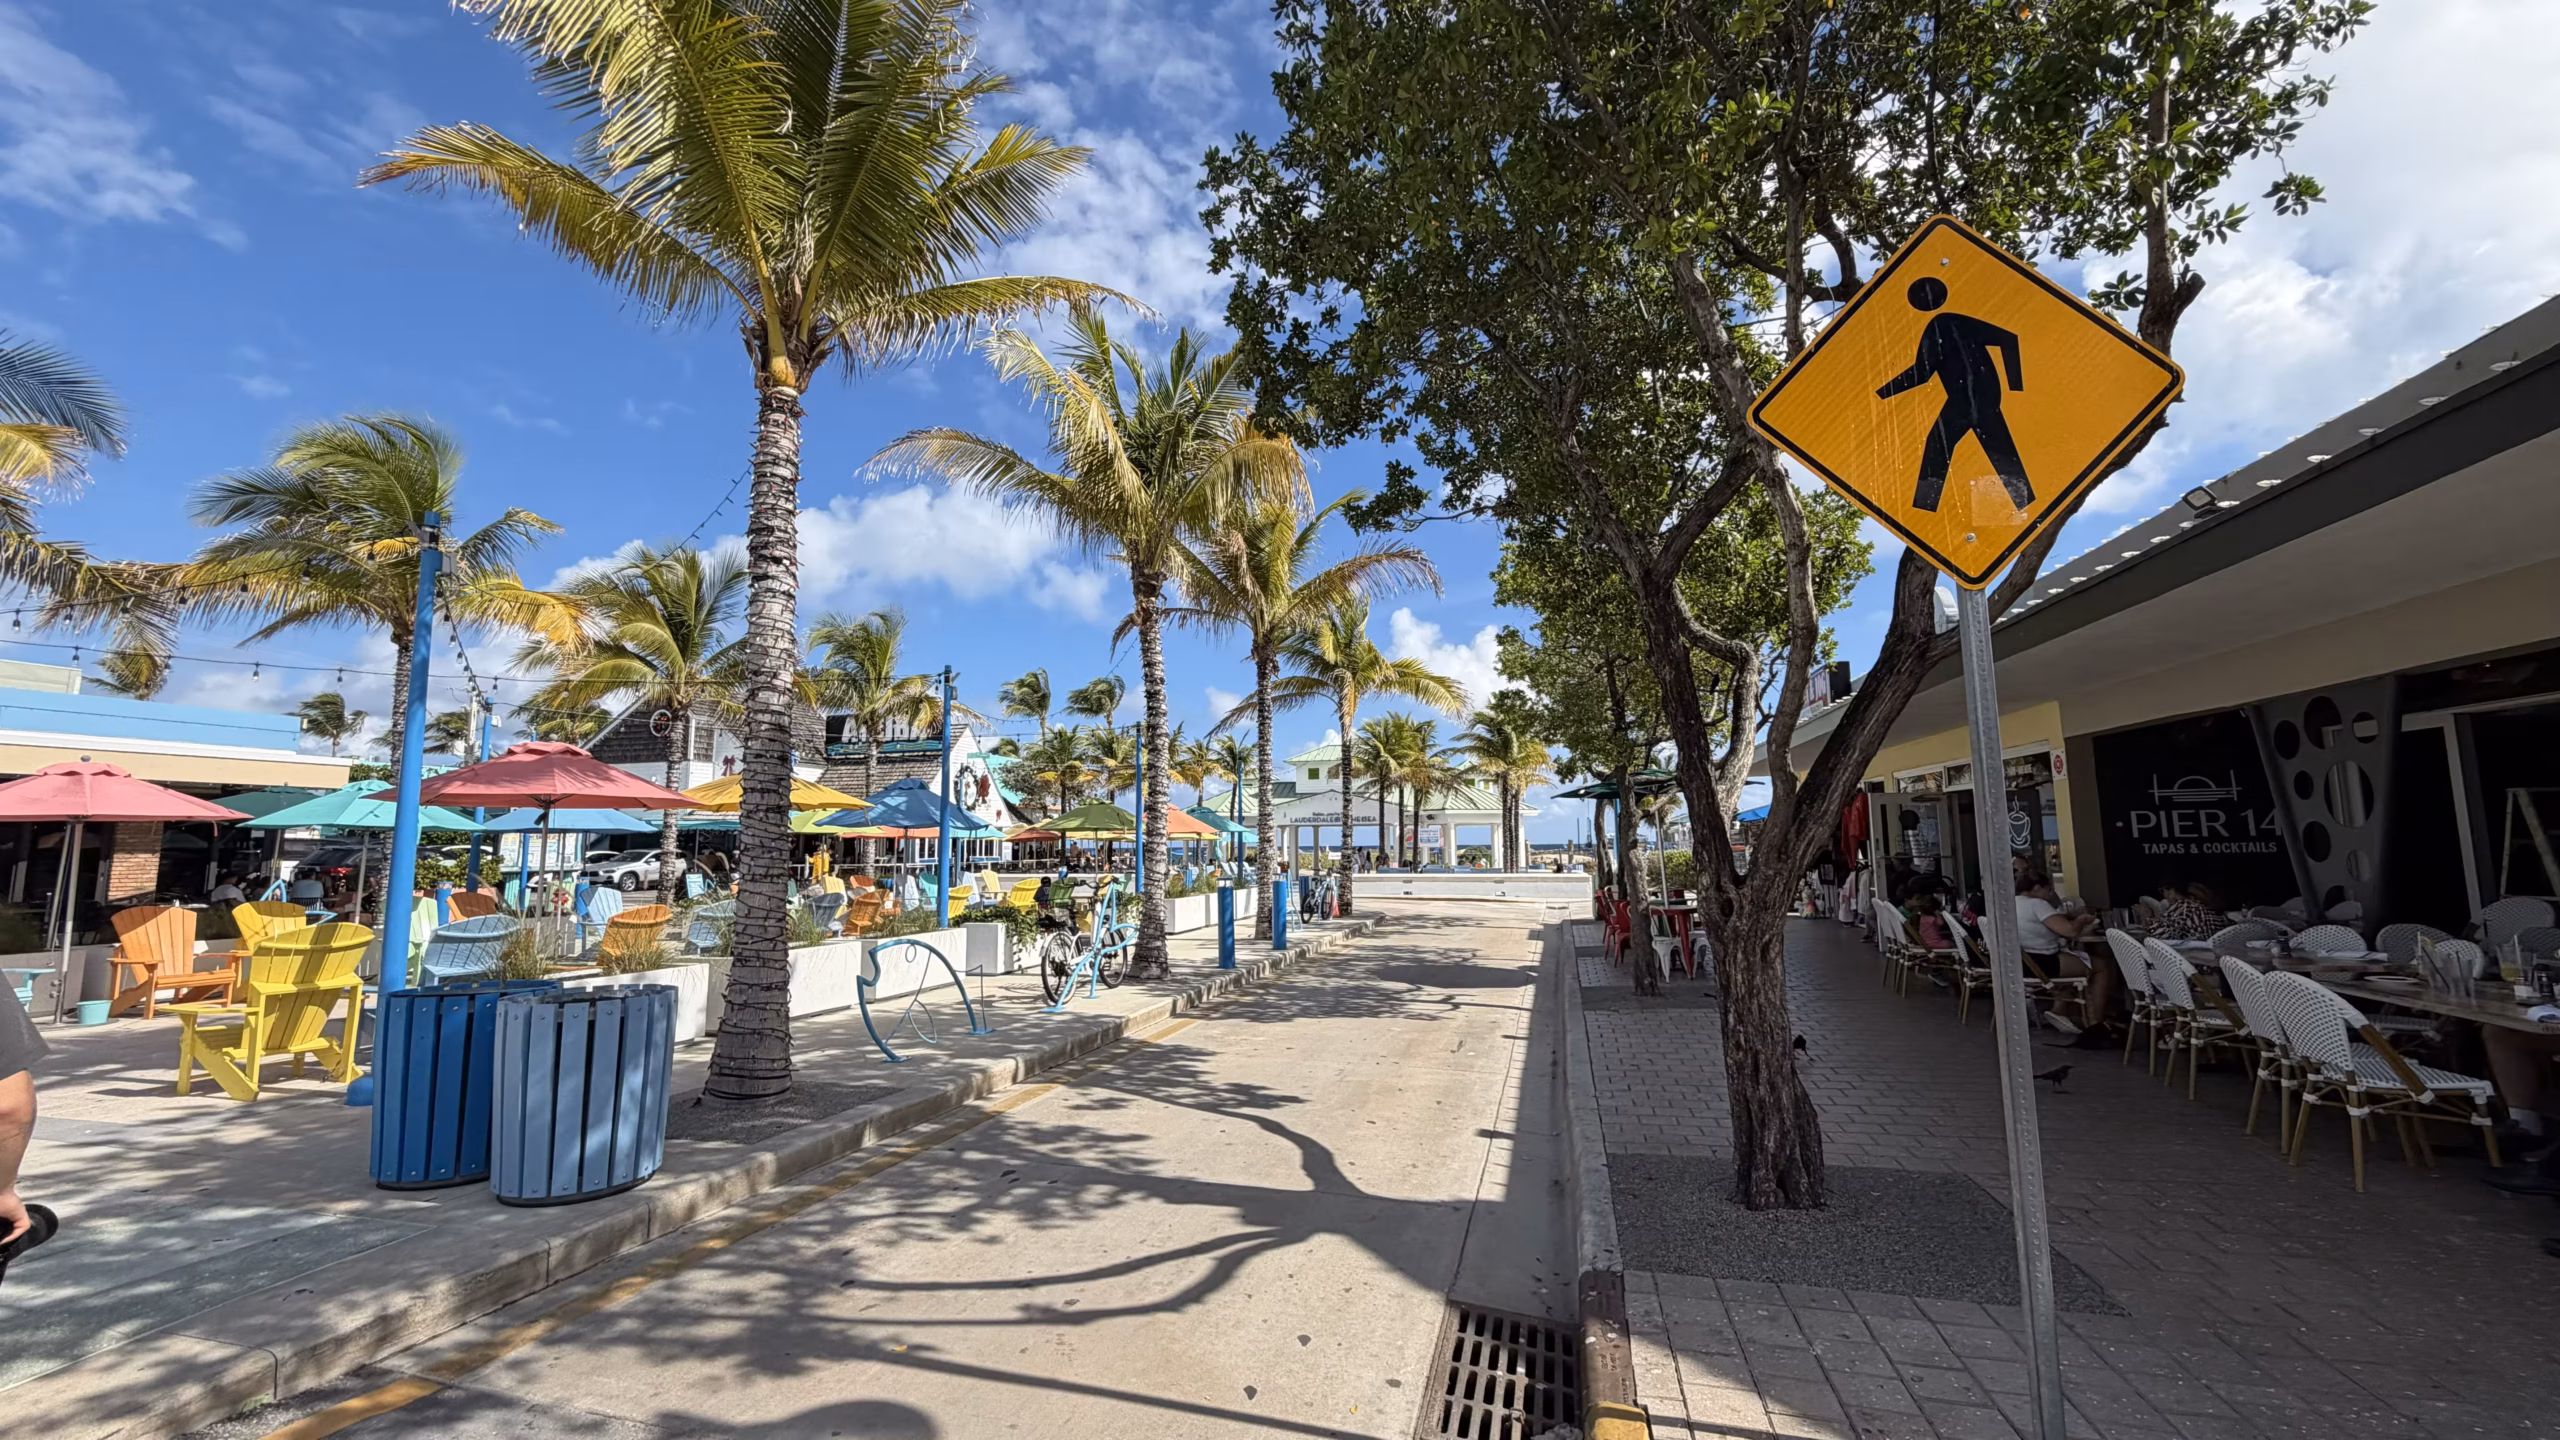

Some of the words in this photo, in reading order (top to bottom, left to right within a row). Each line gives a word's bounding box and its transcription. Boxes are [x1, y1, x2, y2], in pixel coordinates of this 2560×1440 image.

[2130, 809, 2230, 838] PIER
[2239, 808, 2283, 837] 14
[2142, 843, 2185, 854] TAPAS
[2189, 842, 2199, 854] &
[2203, 841, 2278, 854] COCKTAILS
